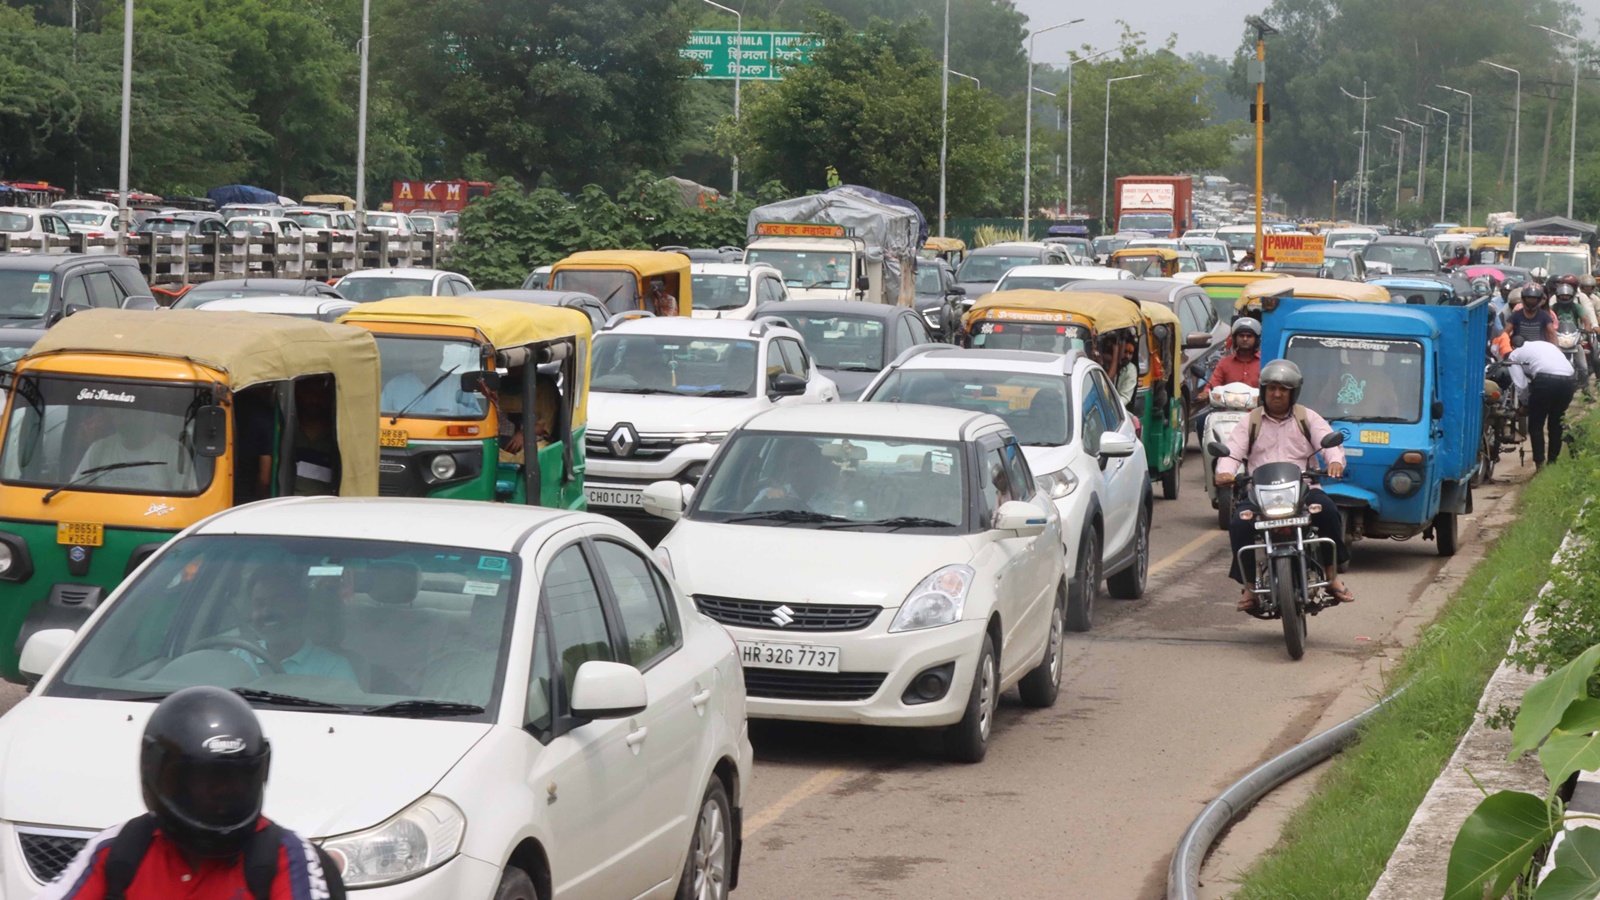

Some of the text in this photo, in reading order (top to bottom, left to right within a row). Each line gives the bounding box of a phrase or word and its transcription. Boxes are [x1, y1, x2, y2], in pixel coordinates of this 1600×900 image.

[727, 36, 763, 46] SHIMLA
[765, 225, 832, 236] हर हर महादेव
[1268, 236, 1304, 250] PAWAN
[94, 389, 136, 403] Shankar
[743, 646, 836, 668] HR 32G 7737
